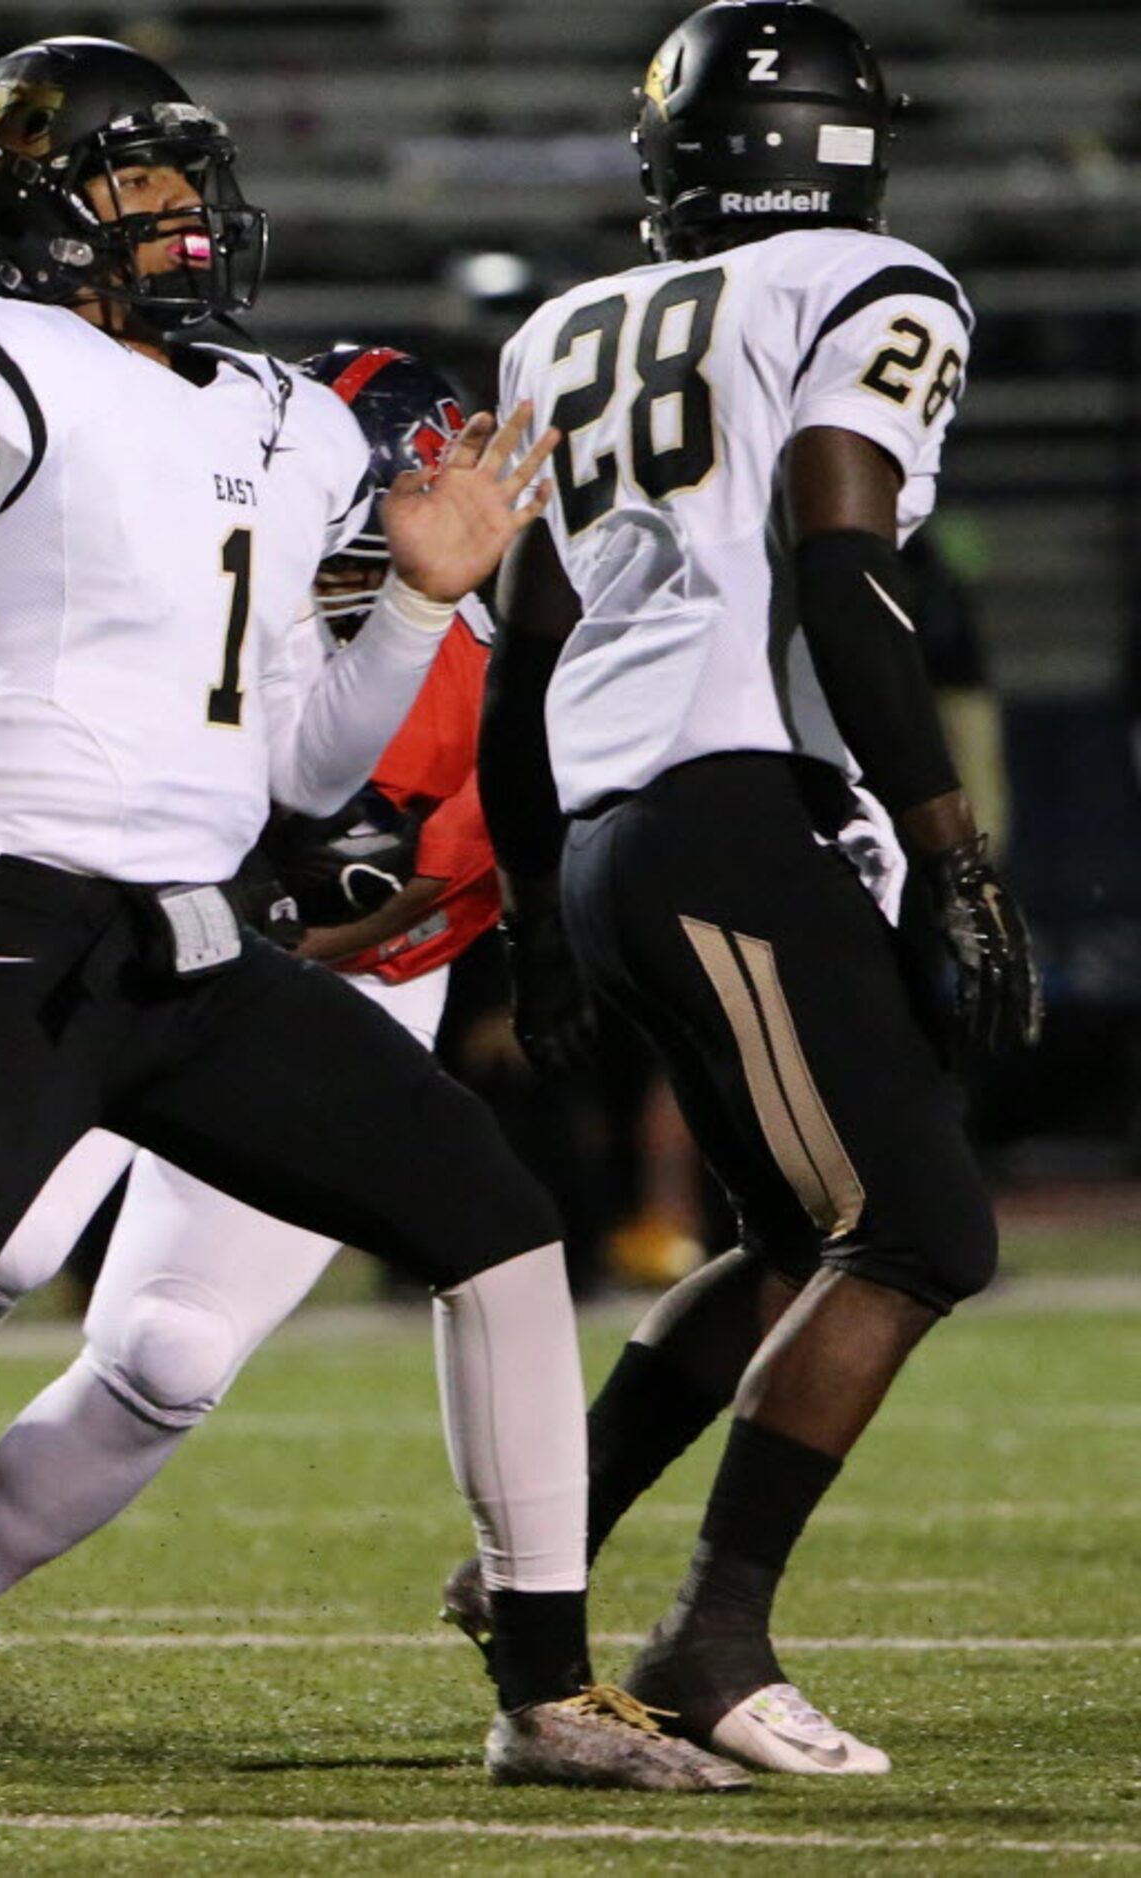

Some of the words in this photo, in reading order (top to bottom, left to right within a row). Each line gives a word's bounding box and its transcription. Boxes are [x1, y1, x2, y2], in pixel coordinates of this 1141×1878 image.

[720, 190, 831, 214] Riddell
[549, 265, 729, 539] 28
[860, 312, 962, 429] 28
[213, 473, 257, 507] EAST
[205, 525, 253, 730] 1
